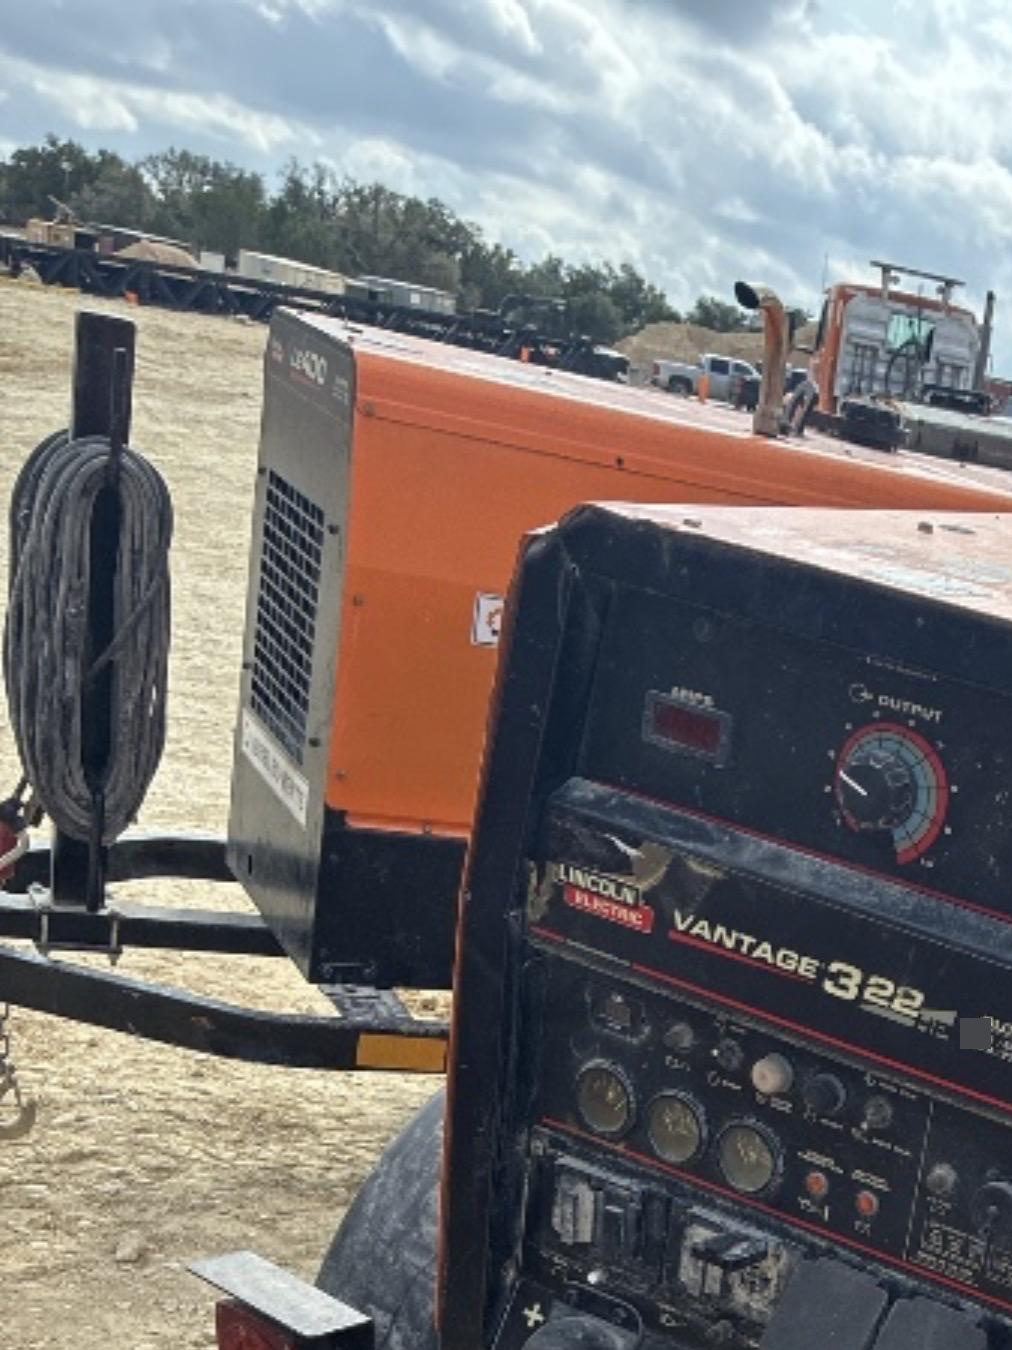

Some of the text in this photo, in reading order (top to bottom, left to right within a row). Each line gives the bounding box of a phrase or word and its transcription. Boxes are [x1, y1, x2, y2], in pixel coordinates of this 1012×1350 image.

[878, 695, 943, 724] OUTPUT
[558, 862, 643, 904] LINCOLN
[673, 907, 821, 980] VANTAGE
[823, 961, 925, 1019] 322
